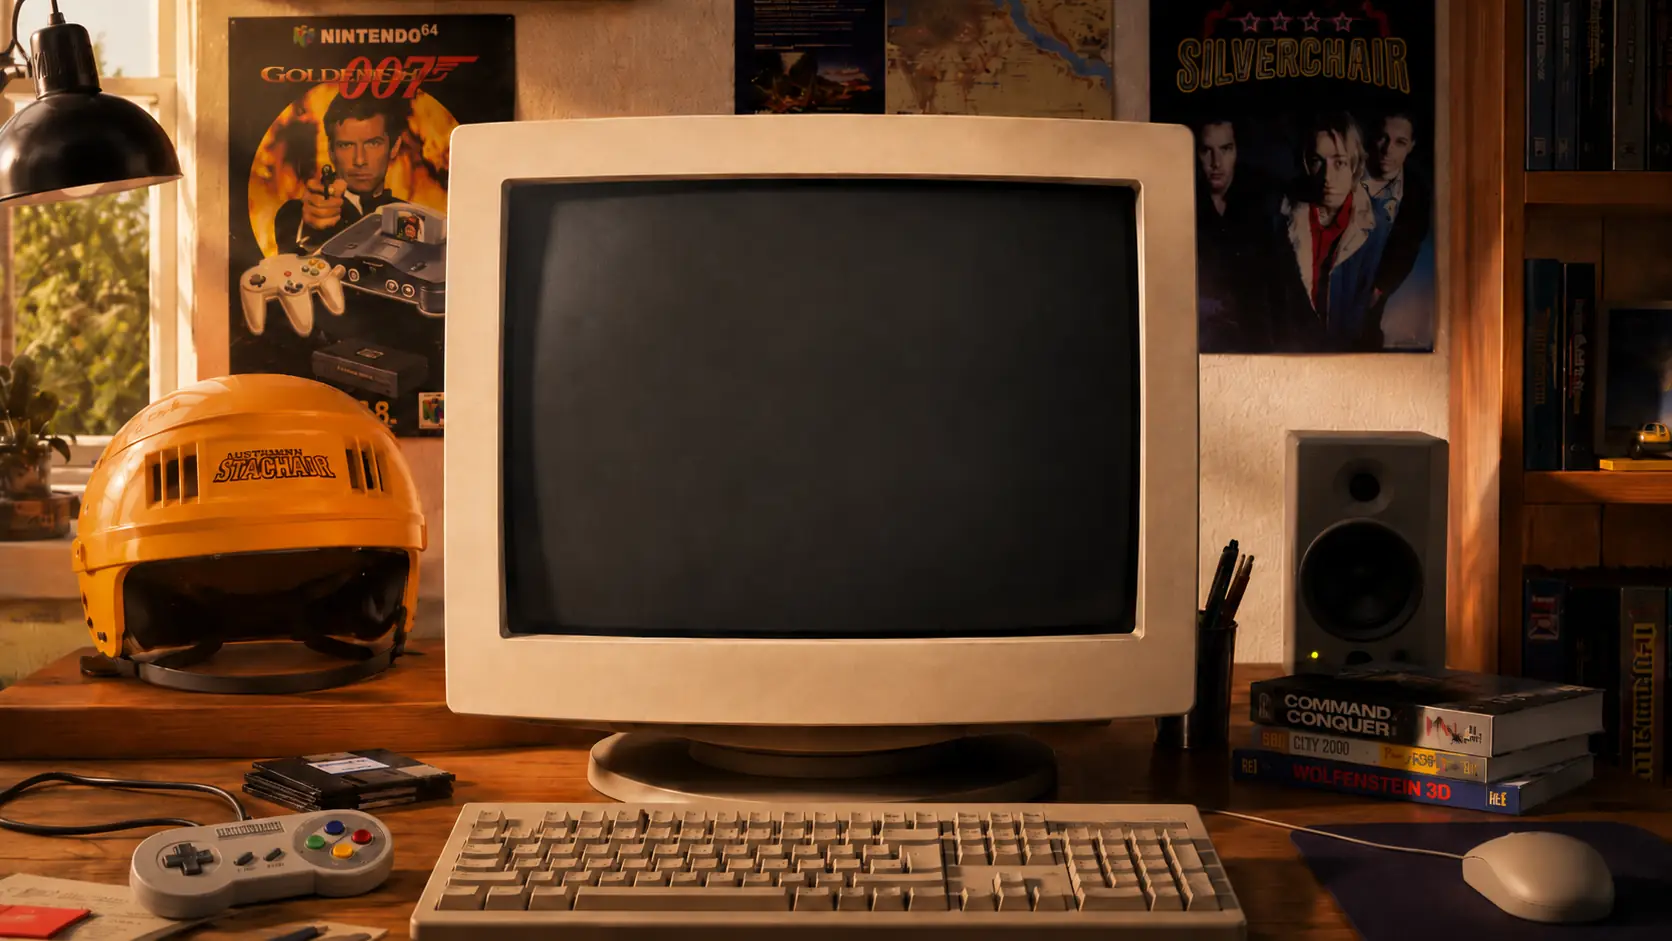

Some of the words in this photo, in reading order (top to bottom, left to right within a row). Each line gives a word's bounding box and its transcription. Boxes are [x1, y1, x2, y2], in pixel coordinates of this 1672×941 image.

[339, 55, 437, 99] 007
[1176, 37, 1411, 95] SILVERCHAIR
[1284, 693, 1392, 720] COMMAND
[1286, 709, 1391, 737] CONQUER
[1293, 735, 1320, 753] CITY
[1322, 739, 1350, 756] 2000
[1291, 762, 1421, 798] WOLFENSTEIN
[1426, 781, 1452, 801] 3D
